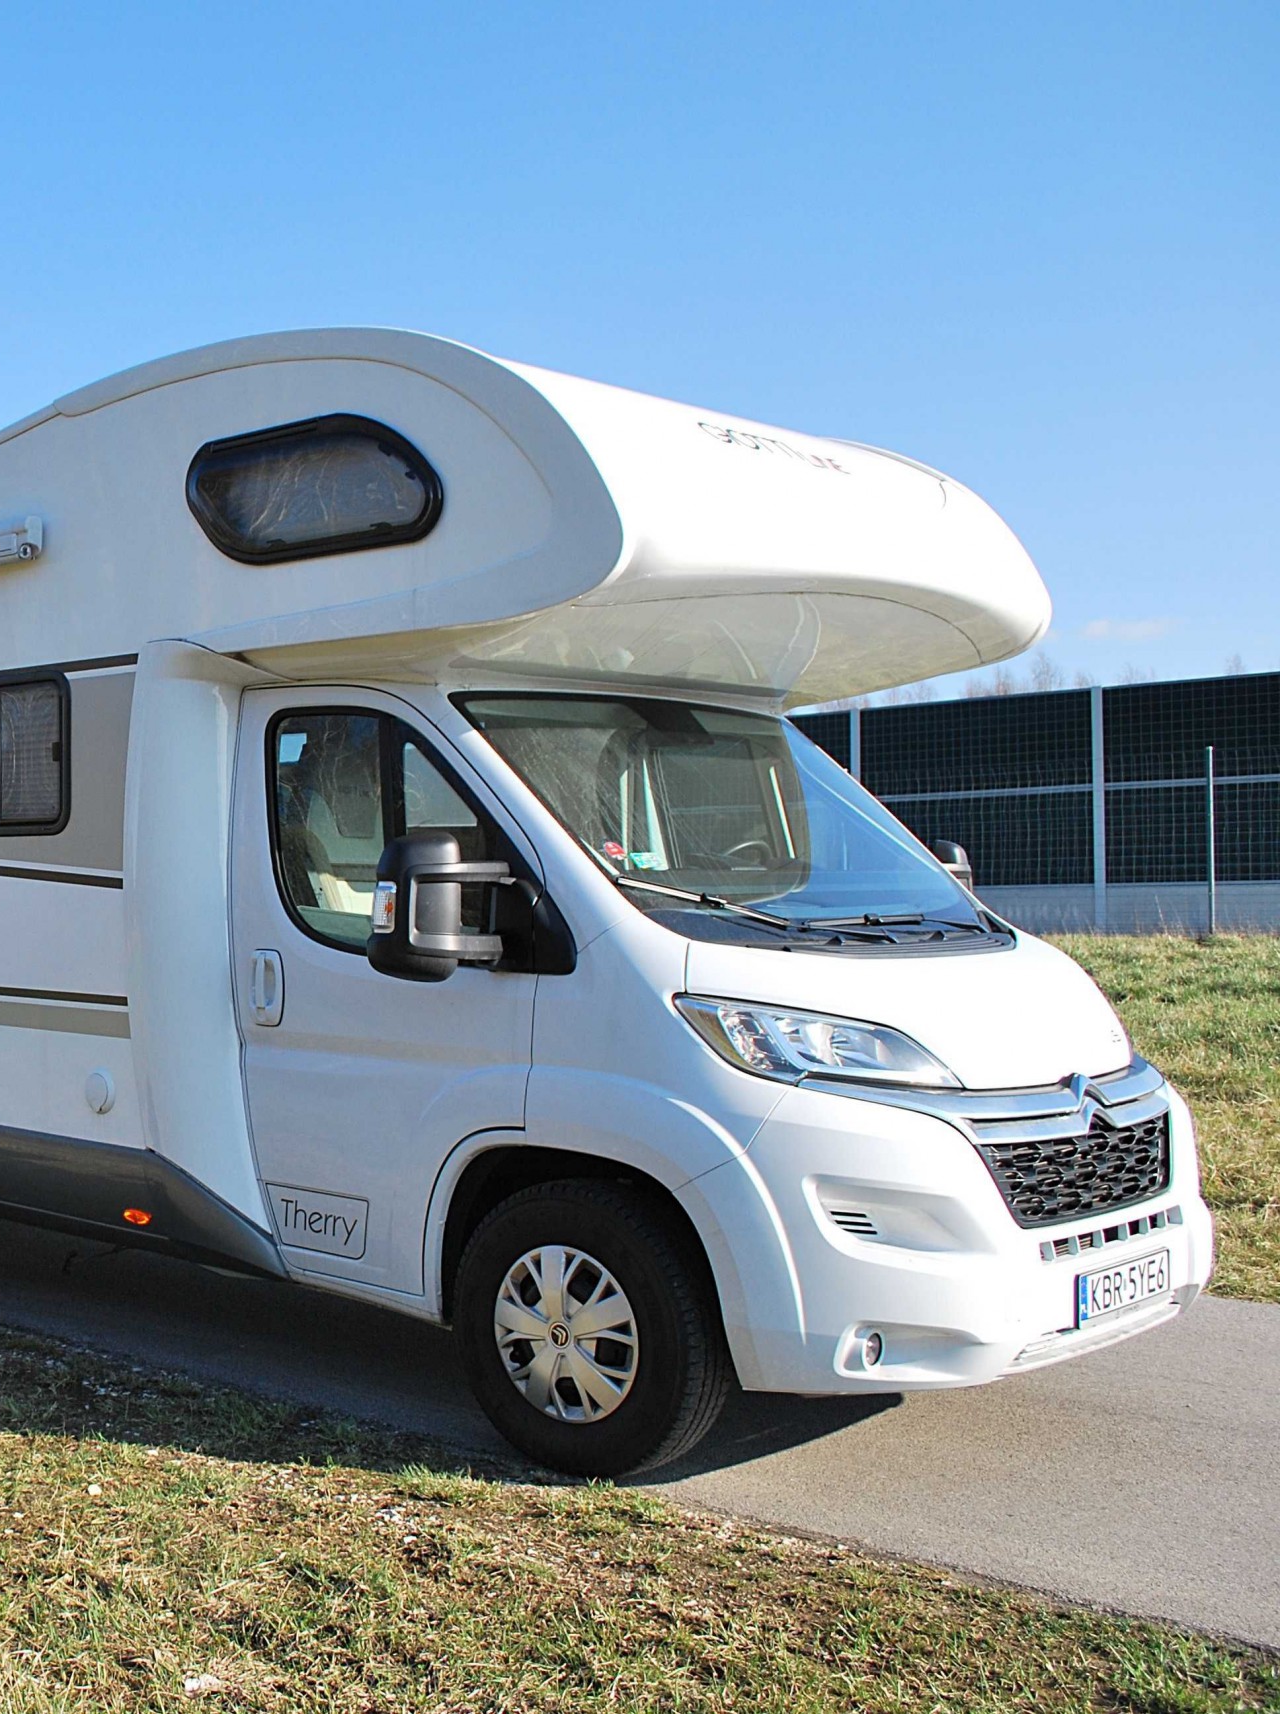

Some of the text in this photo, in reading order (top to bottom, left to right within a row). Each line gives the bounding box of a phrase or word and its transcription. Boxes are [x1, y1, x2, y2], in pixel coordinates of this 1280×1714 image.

[280, 1198, 358, 1246] Therry
[1091, 1256, 1165, 1313] KBR 5YE6
